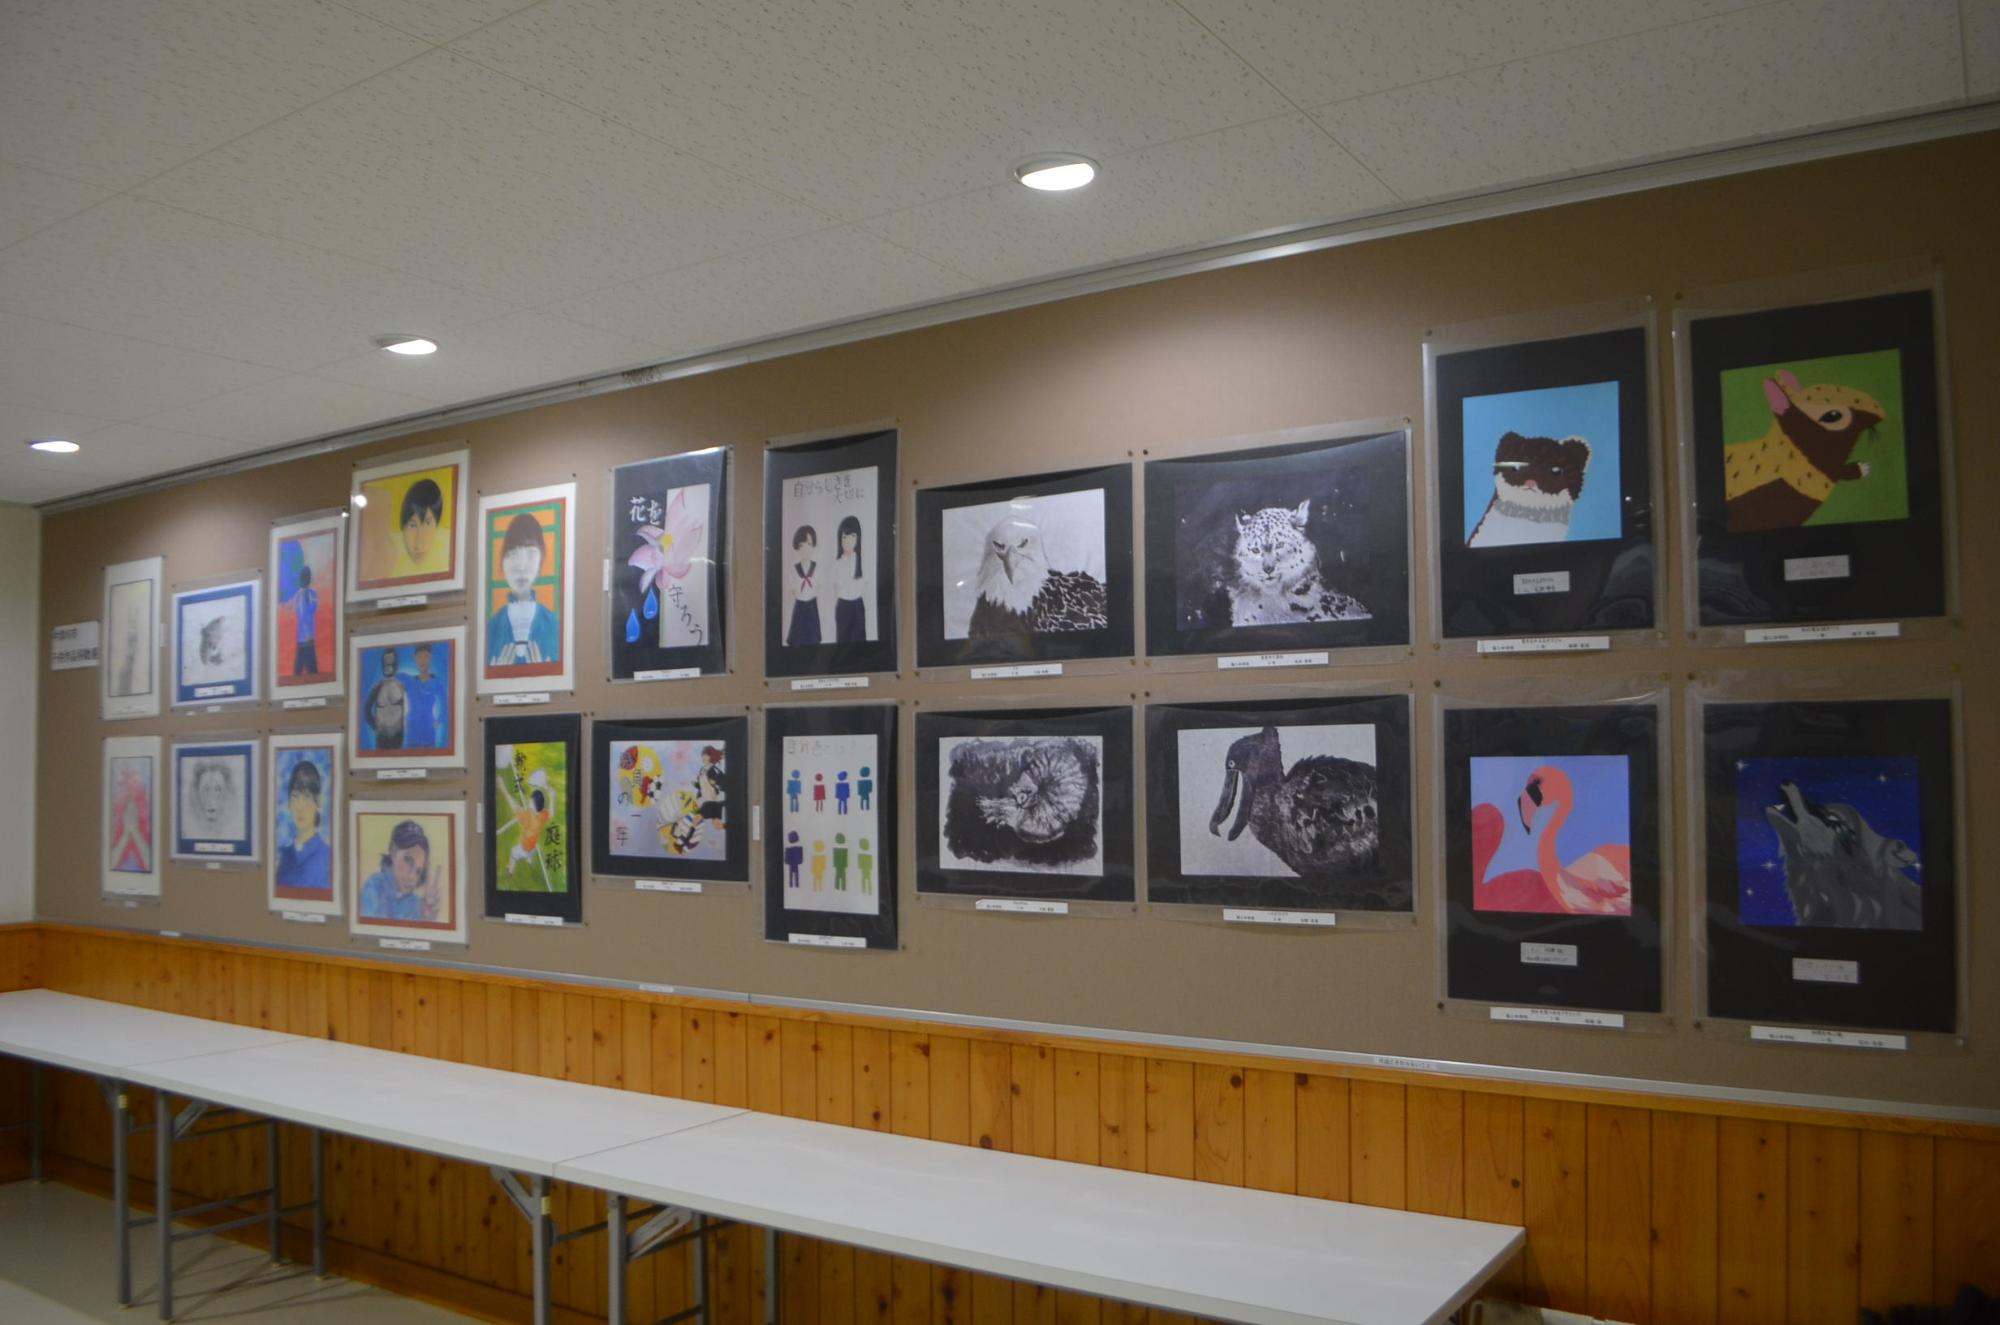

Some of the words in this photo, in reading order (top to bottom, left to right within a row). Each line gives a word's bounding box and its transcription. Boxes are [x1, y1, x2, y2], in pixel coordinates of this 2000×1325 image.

[629, 496, 662, 525] 花を
[668, 584, 703, 646] 守ろう
